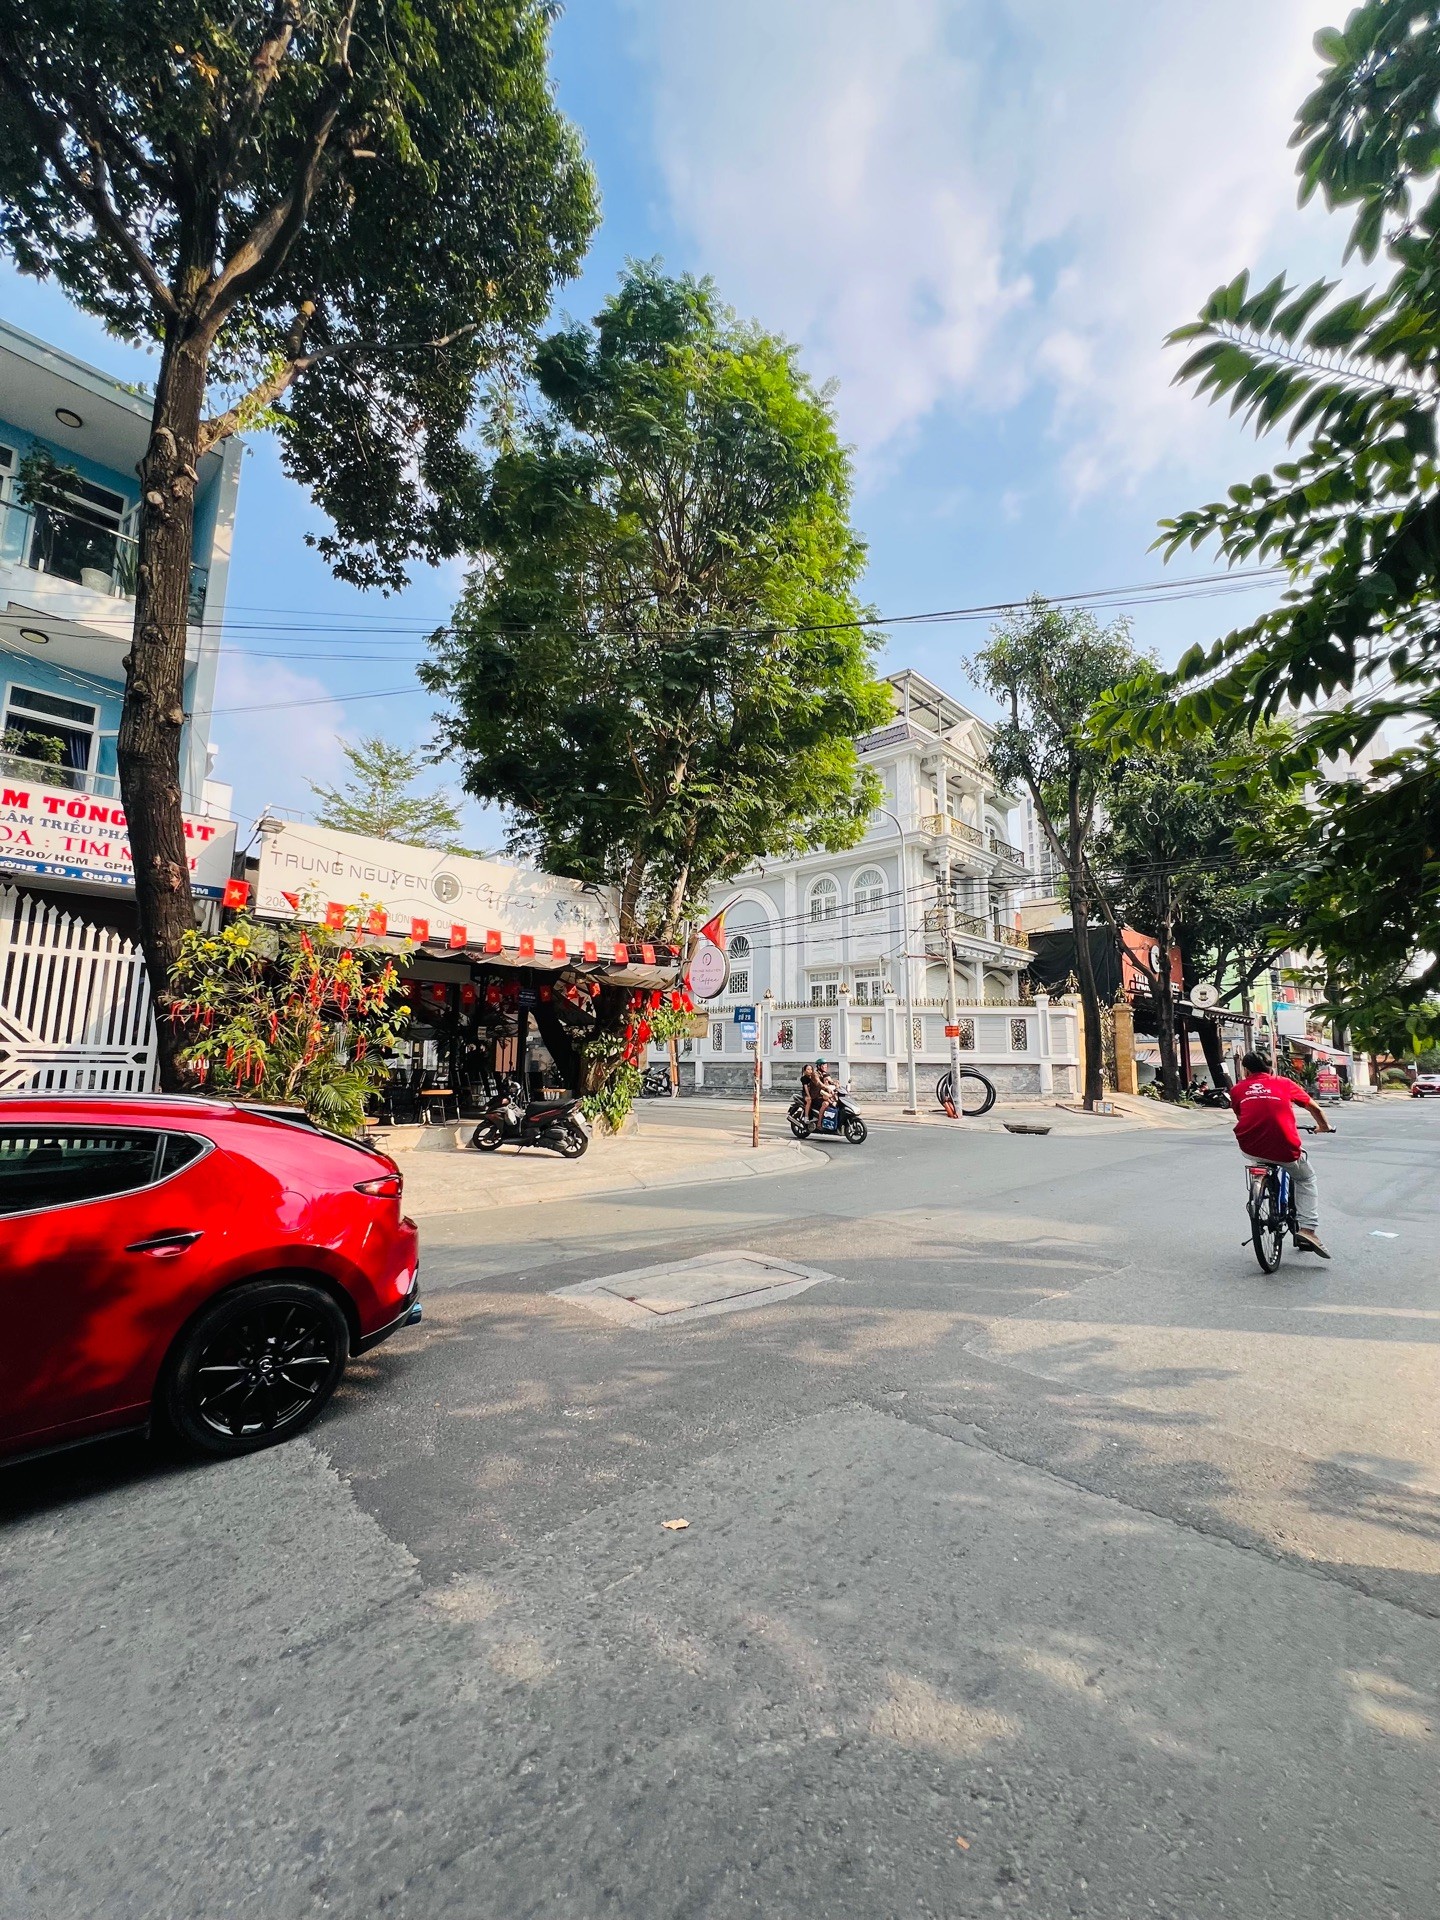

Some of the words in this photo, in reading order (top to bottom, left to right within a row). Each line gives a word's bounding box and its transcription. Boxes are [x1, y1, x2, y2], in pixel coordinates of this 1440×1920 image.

[43, 795, 128, 827] TỔNG
[58, 835, 112, 858] TIM
[44, 865, 66, 876] 10
[81, 870, 123, 884] Quận
[270, 850, 344, 876] TRUNG
[349, 864, 429, 891] NGUYEN
[476, 882, 538, 912] Coffee
[265, 895, 286, 908] 206
